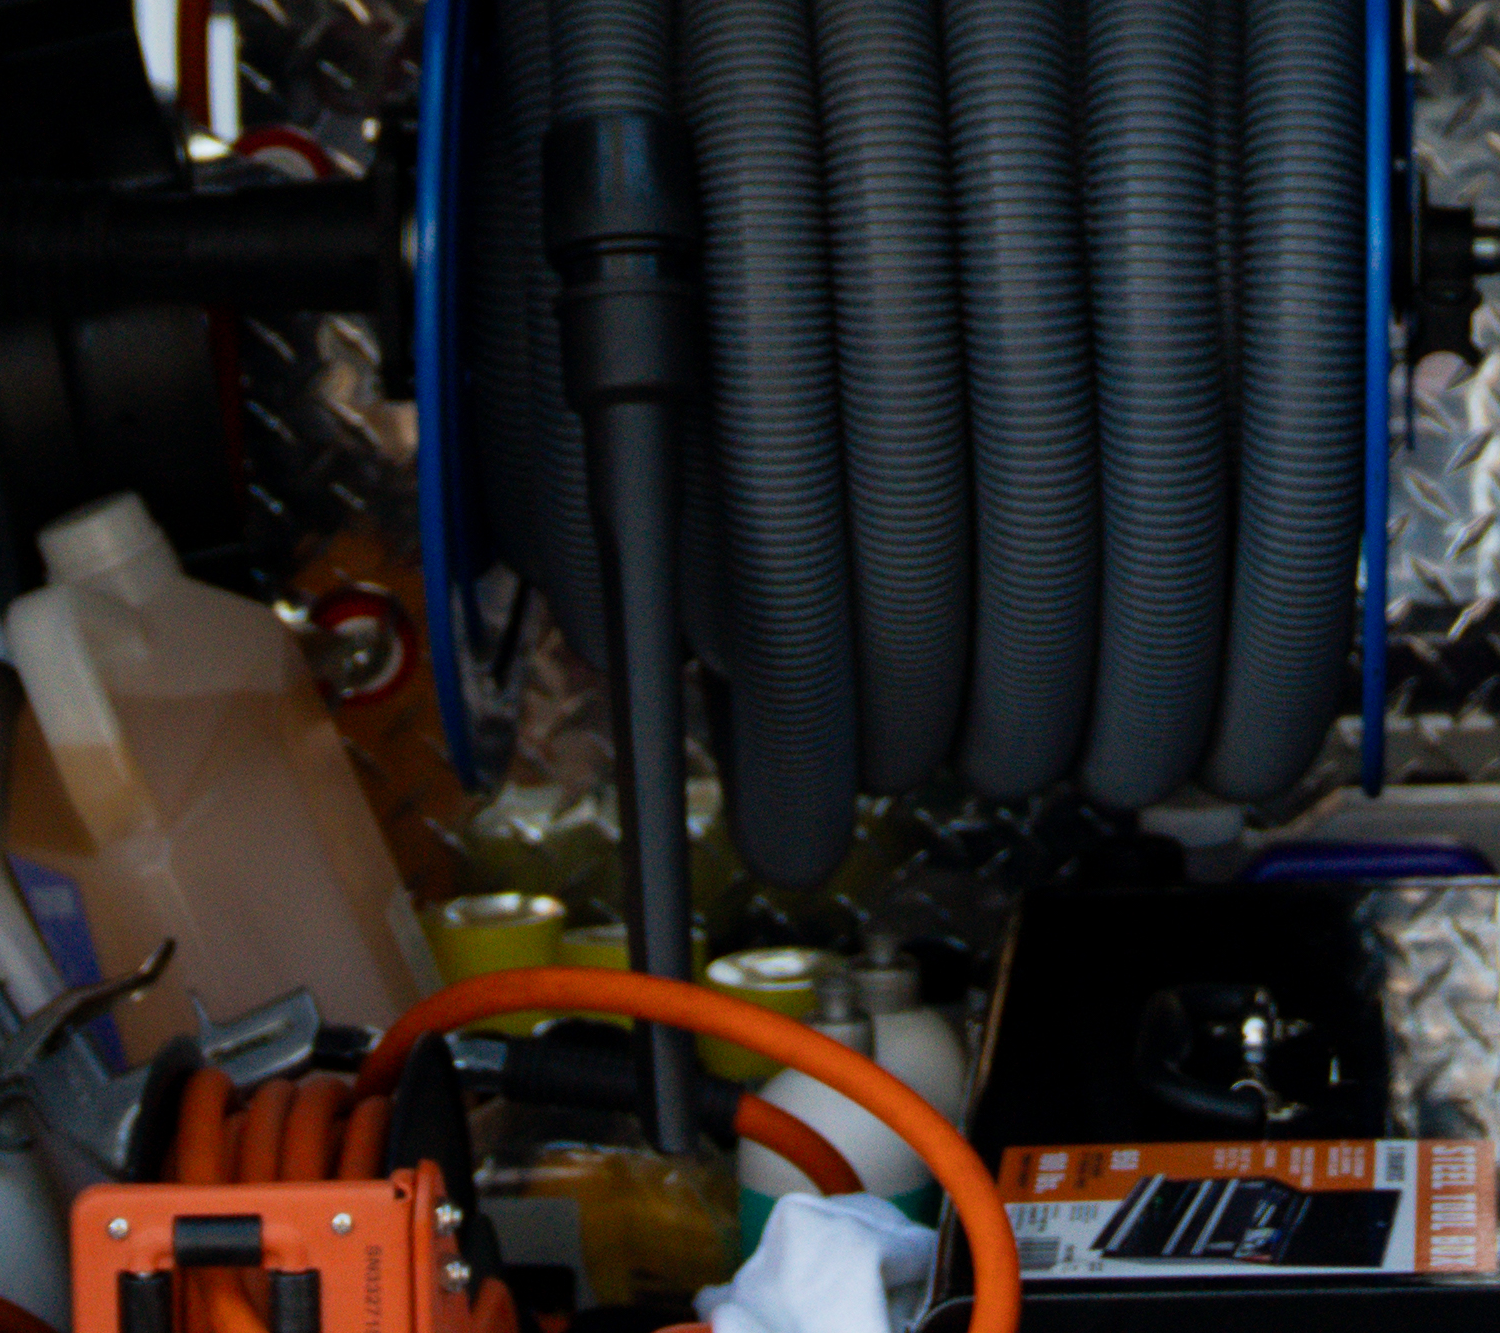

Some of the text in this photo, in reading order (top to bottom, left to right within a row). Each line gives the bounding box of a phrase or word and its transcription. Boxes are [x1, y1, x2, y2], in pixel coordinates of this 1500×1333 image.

[1429, 1145, 1476, 1267] STEEL TOOL BOX
